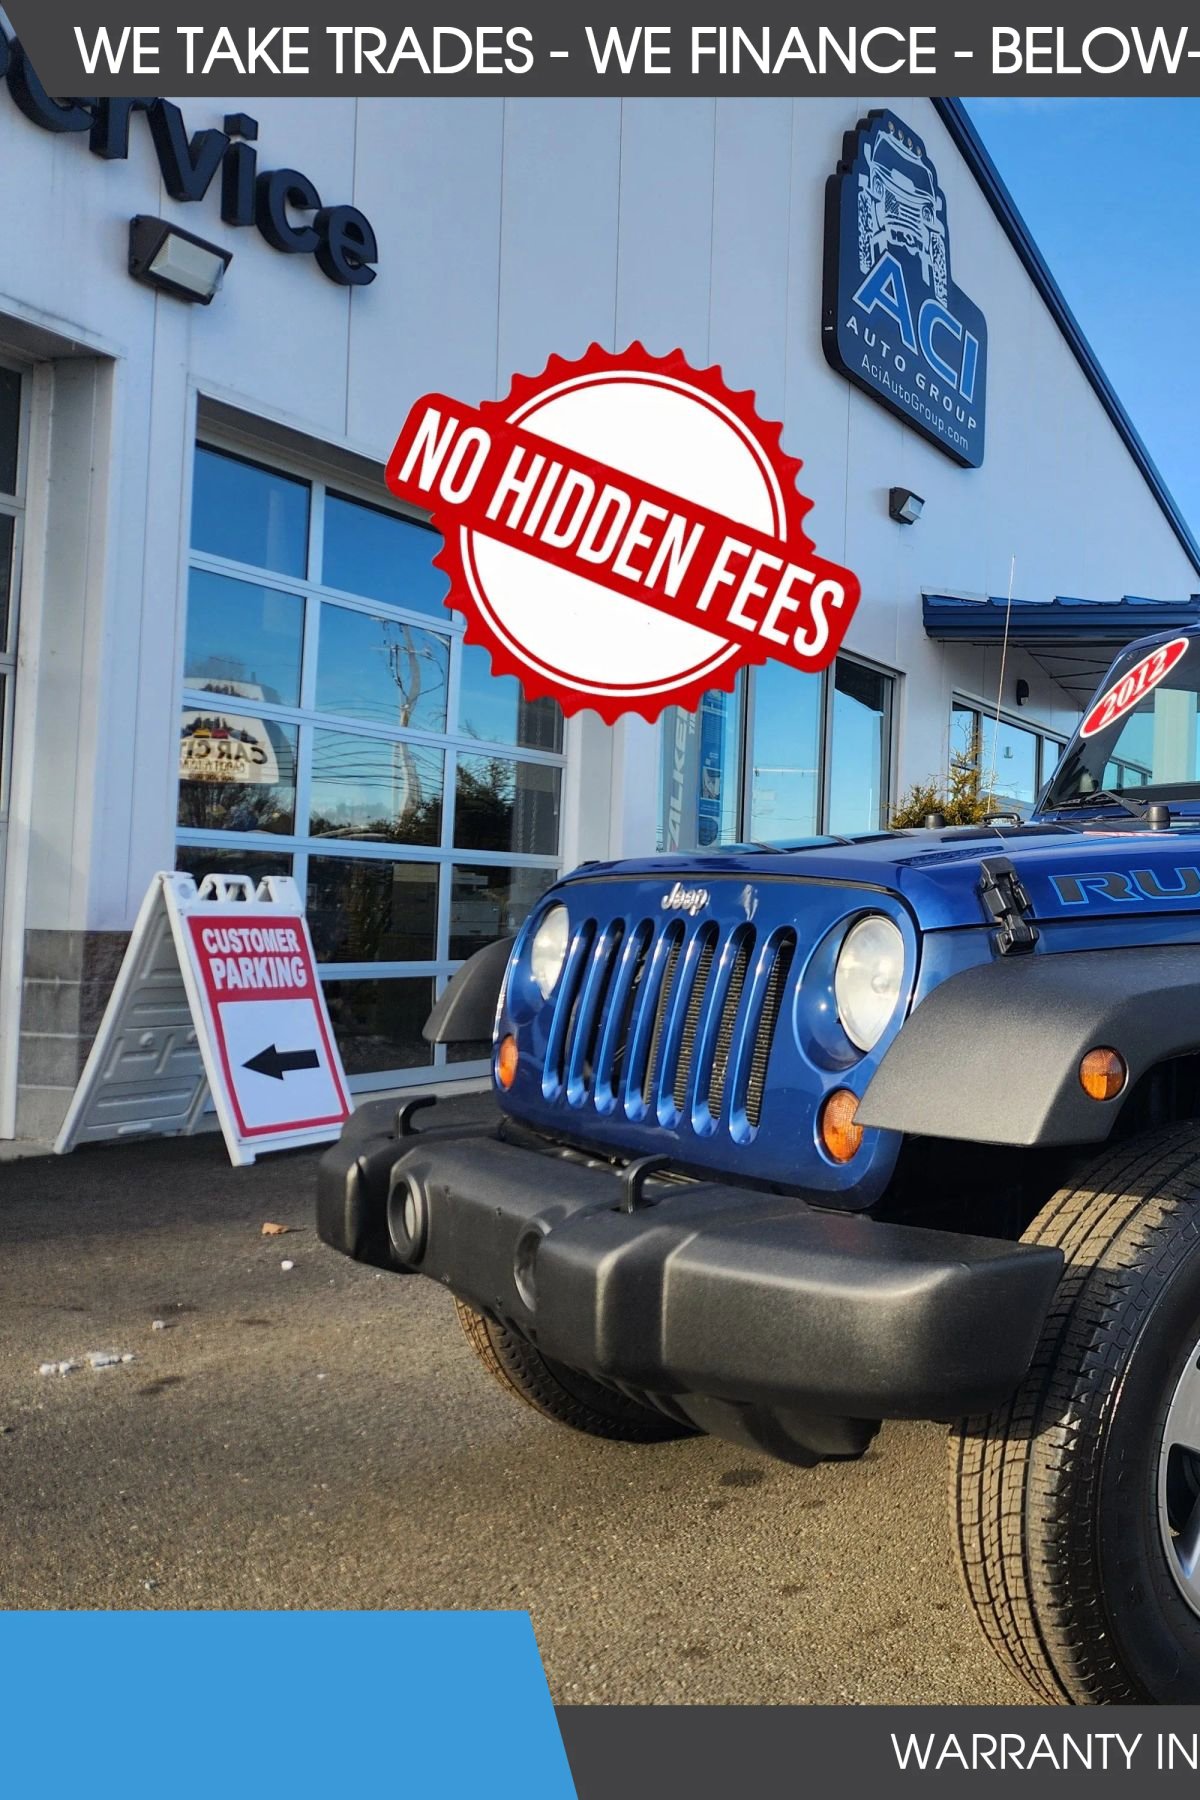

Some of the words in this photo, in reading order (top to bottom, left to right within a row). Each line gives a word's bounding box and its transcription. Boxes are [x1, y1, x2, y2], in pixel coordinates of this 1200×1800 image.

[0, 26, 378, 285] rvice
[852, 251, 978, 403] ACI
[846, 315, 906, 373] AUTO
[915, 372, 977, 430] GROUP
[861, 354, 969, 451] AciAutoGroup.com
[1098, 649, 1167, 726] 2012
[202, 928, 301, 953] CUSTOMER
[661, 882, 708, 916] Jeep
[209, 956, 308, 990] PARKING
